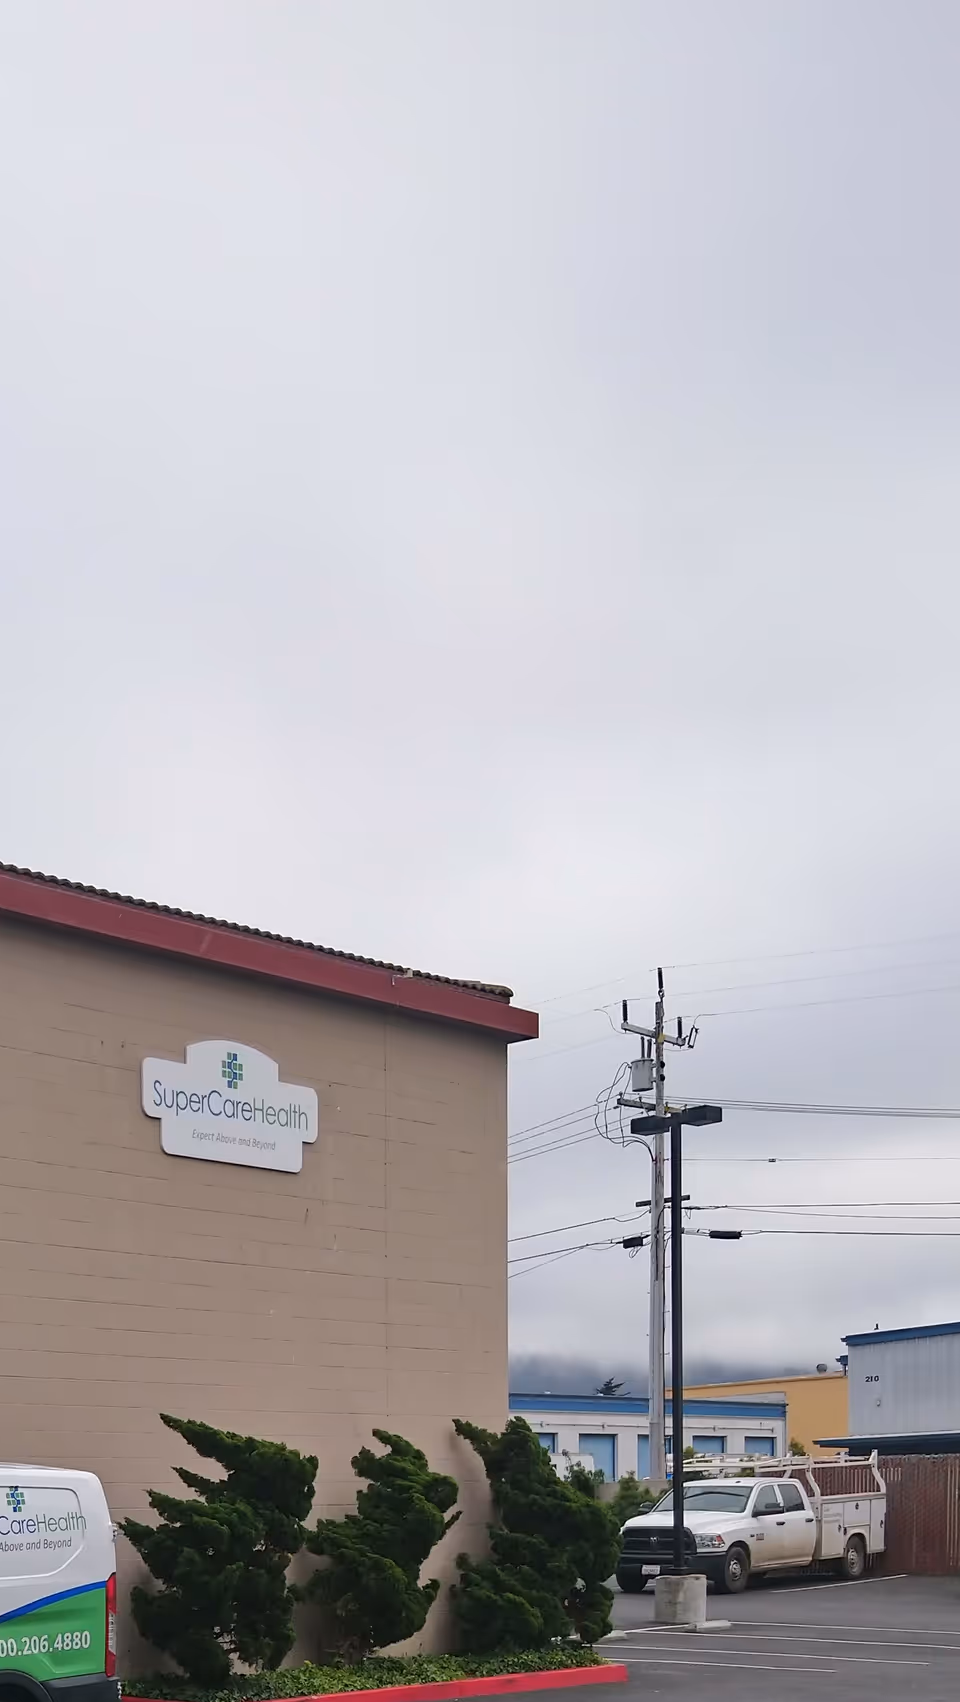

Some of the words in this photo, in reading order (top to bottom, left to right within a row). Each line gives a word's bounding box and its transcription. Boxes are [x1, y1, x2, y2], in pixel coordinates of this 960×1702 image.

[152, 1079, 309, 1131] SuperCareHealth
[191, 1128, 215, 1142] Expect
[215, 1132, 237, 1145] Above
[238, 1137, 251, 1147] and
[251, 1138, 276, 1151] Beyond
[865, 1375, 880, 1383] 210
[25, 1539, 41, 1550] and
[43, 1536, 72, 1551] Beyond
